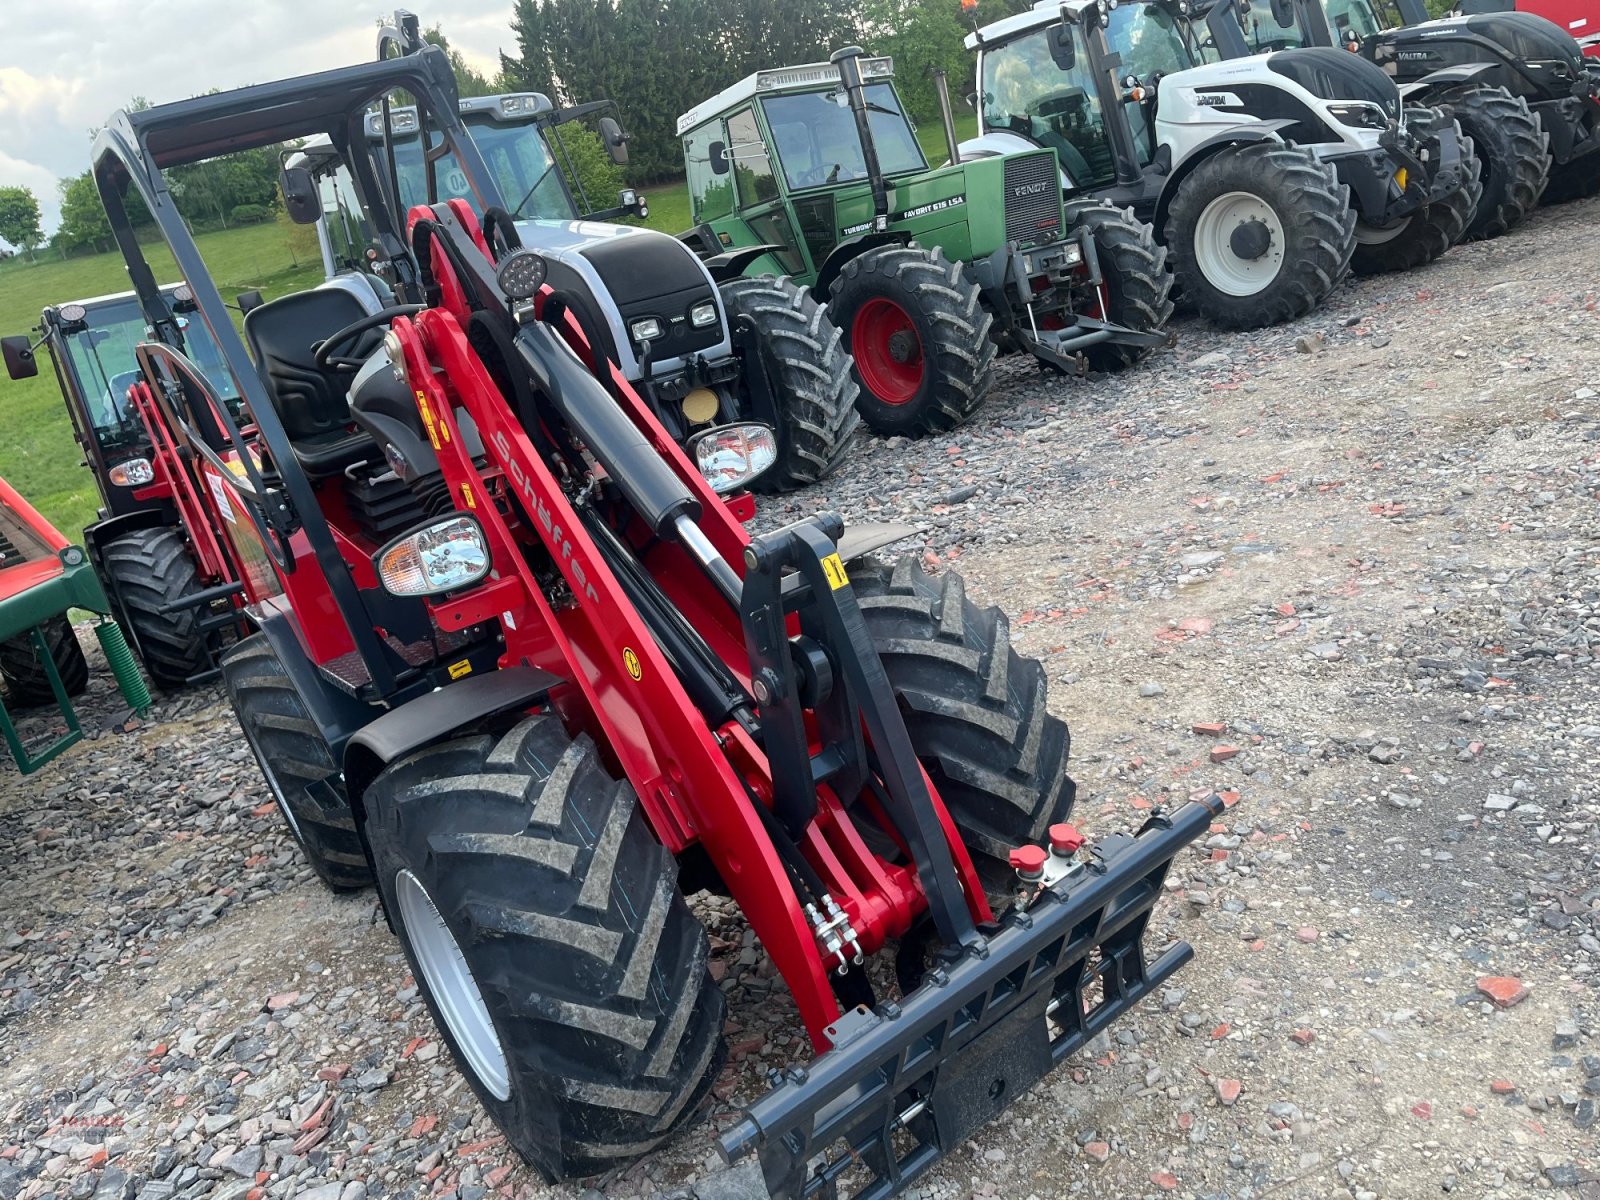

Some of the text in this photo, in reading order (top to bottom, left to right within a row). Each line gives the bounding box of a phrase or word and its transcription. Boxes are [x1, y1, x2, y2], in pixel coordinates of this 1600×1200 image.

[1398, 52, 1427, 60] VALTRA
[1197, 95, 1226, 106] VALTRA
[1015, 182, 1046, 196] FENDT
[843, 221, 873, 235] TURBOM
[904, 205, 932, 219] FAVORIT
[948, 196, 963, 206] LSA
[490, 430, 599, 603] Schäffer
